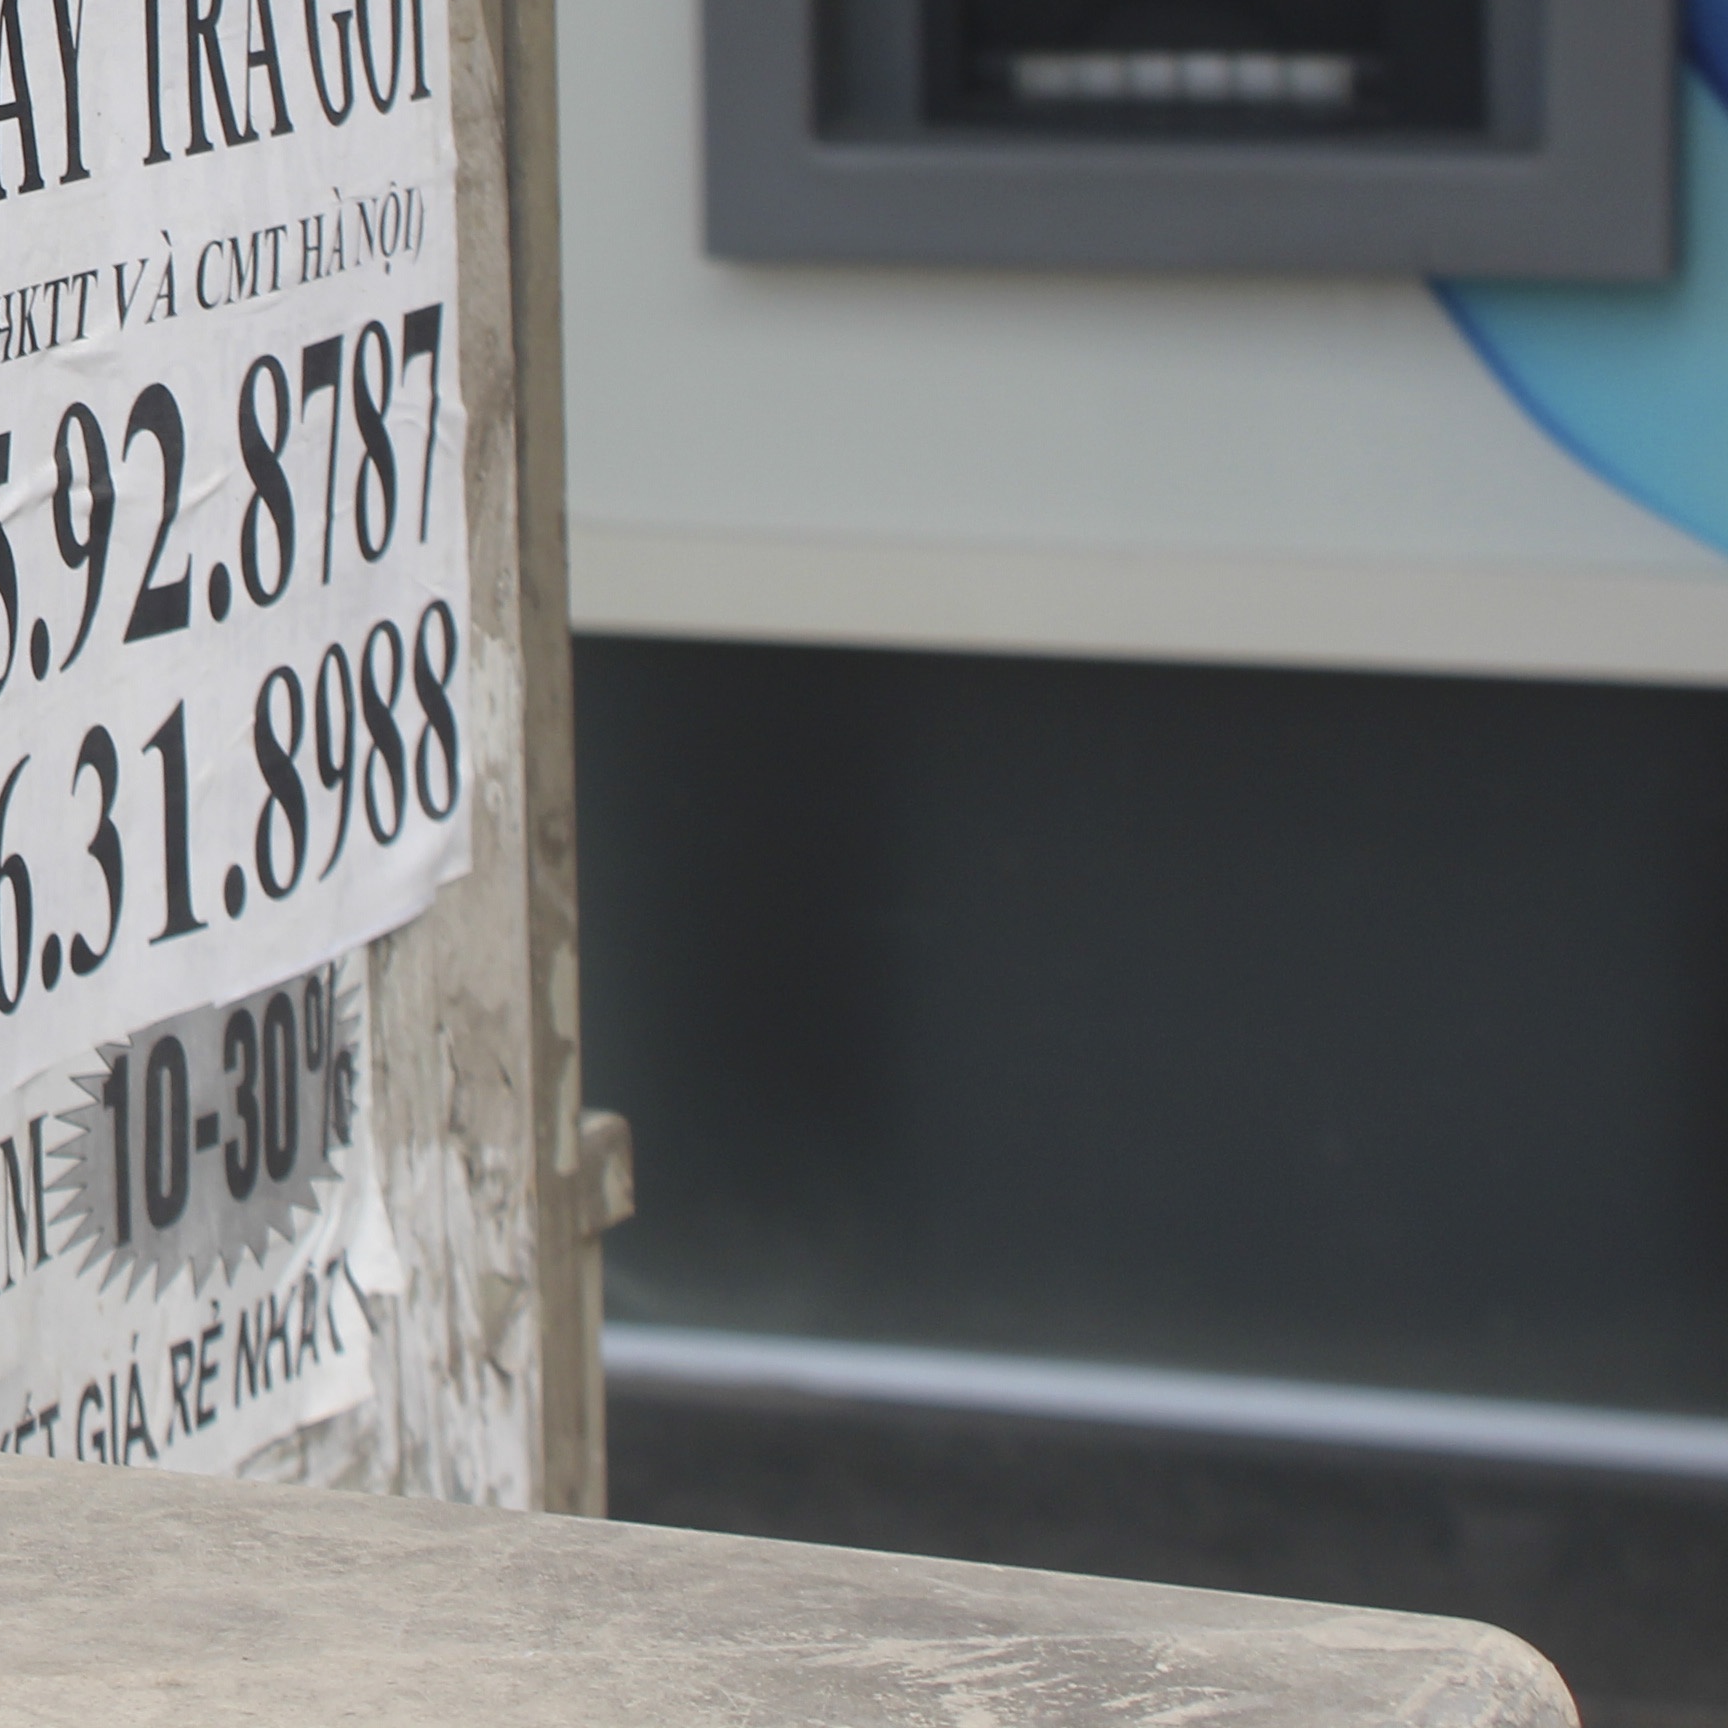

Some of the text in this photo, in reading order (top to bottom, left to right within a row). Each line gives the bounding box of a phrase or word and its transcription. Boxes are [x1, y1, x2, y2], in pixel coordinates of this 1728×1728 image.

[112, 231, 179, 332] VÀ
[194, 225, 290, 312] CMT
[299, 184, 348, 283] HÀ
[352, 180, 426, 275] NỘI)
[104, 961, 352, 1248] 10-30%
[77, 1330, 159, 1466] GIÁ
